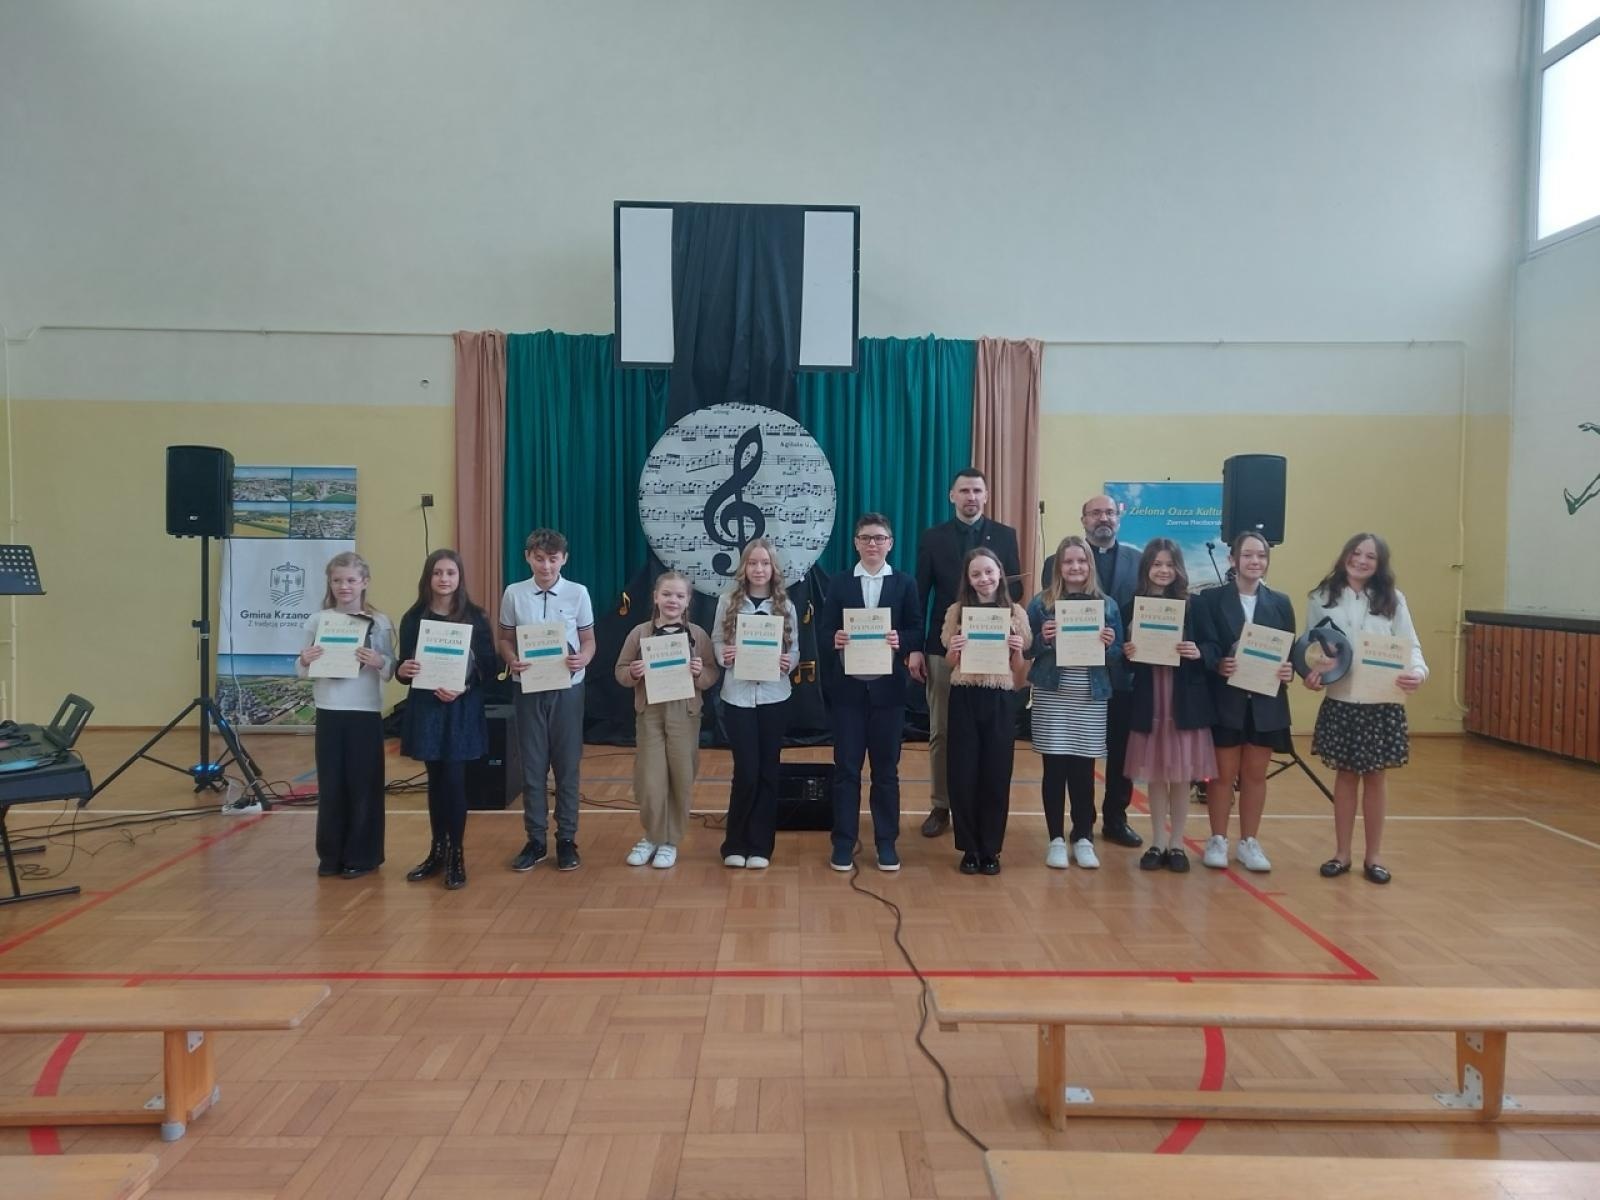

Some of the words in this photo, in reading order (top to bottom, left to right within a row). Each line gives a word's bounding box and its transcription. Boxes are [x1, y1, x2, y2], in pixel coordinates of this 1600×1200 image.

[1129, 507, 1165, 516] Zielona
[1168, 507, 1193, 516] Oaza
[240, 609, 272, 619] Gmina
